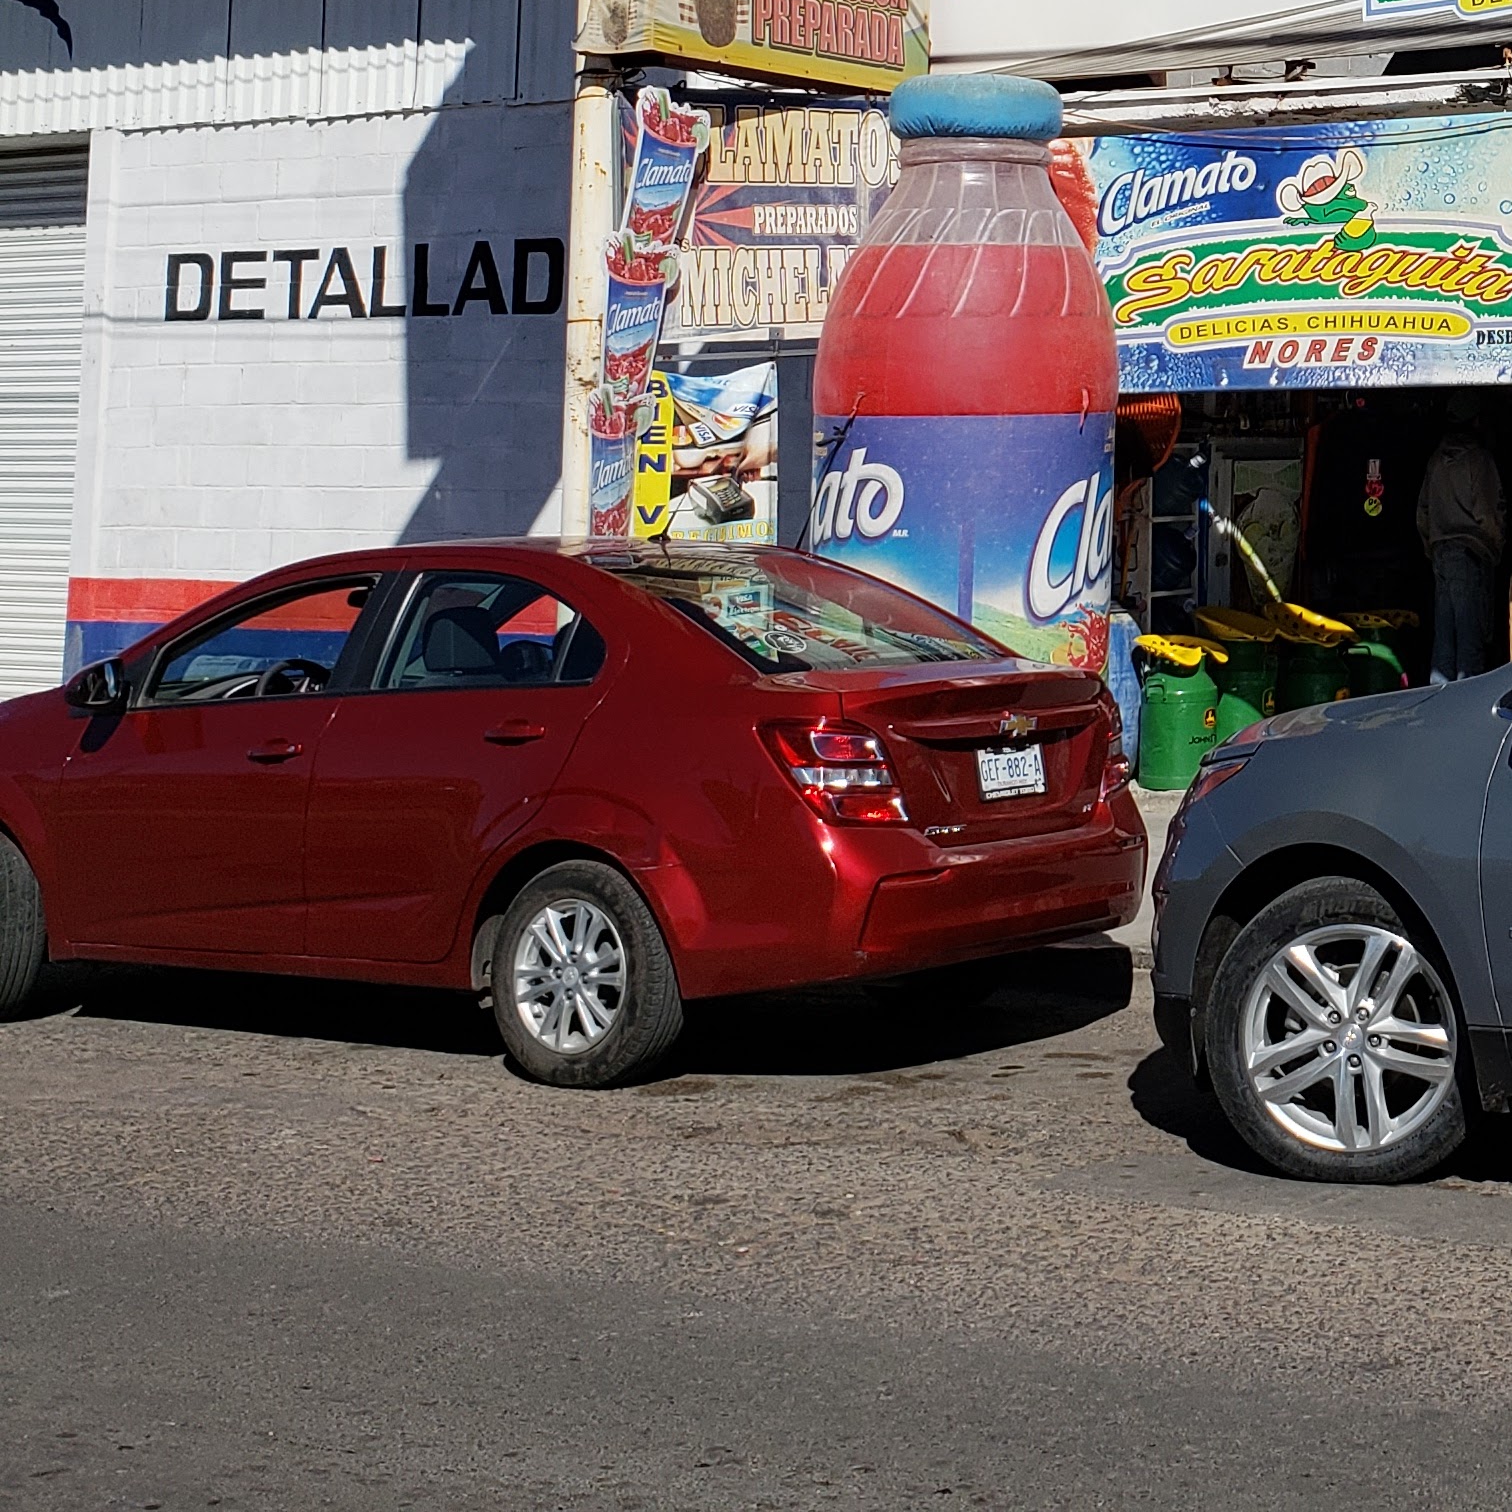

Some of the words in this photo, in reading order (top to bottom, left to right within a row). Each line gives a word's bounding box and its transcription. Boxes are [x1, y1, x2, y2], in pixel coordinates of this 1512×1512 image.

[697, 106, 900, 186] LAMATO
[636, 157, 692, 187] Clamato
[1098, 151, 1256, 237] Clamato
[753, 205, 858, 236] PREPARADOS
[164, 237, 566, 321] DETALLAD
[606, 296, 660, 335] Clamato
[1179, 318, 1297, 341] DELICIAS,
[1306, 316, 1451, 331] CHIHUAHUA
[1249, 337, 1378, 365] NORES
[694, 424, 713, 443] VISA
